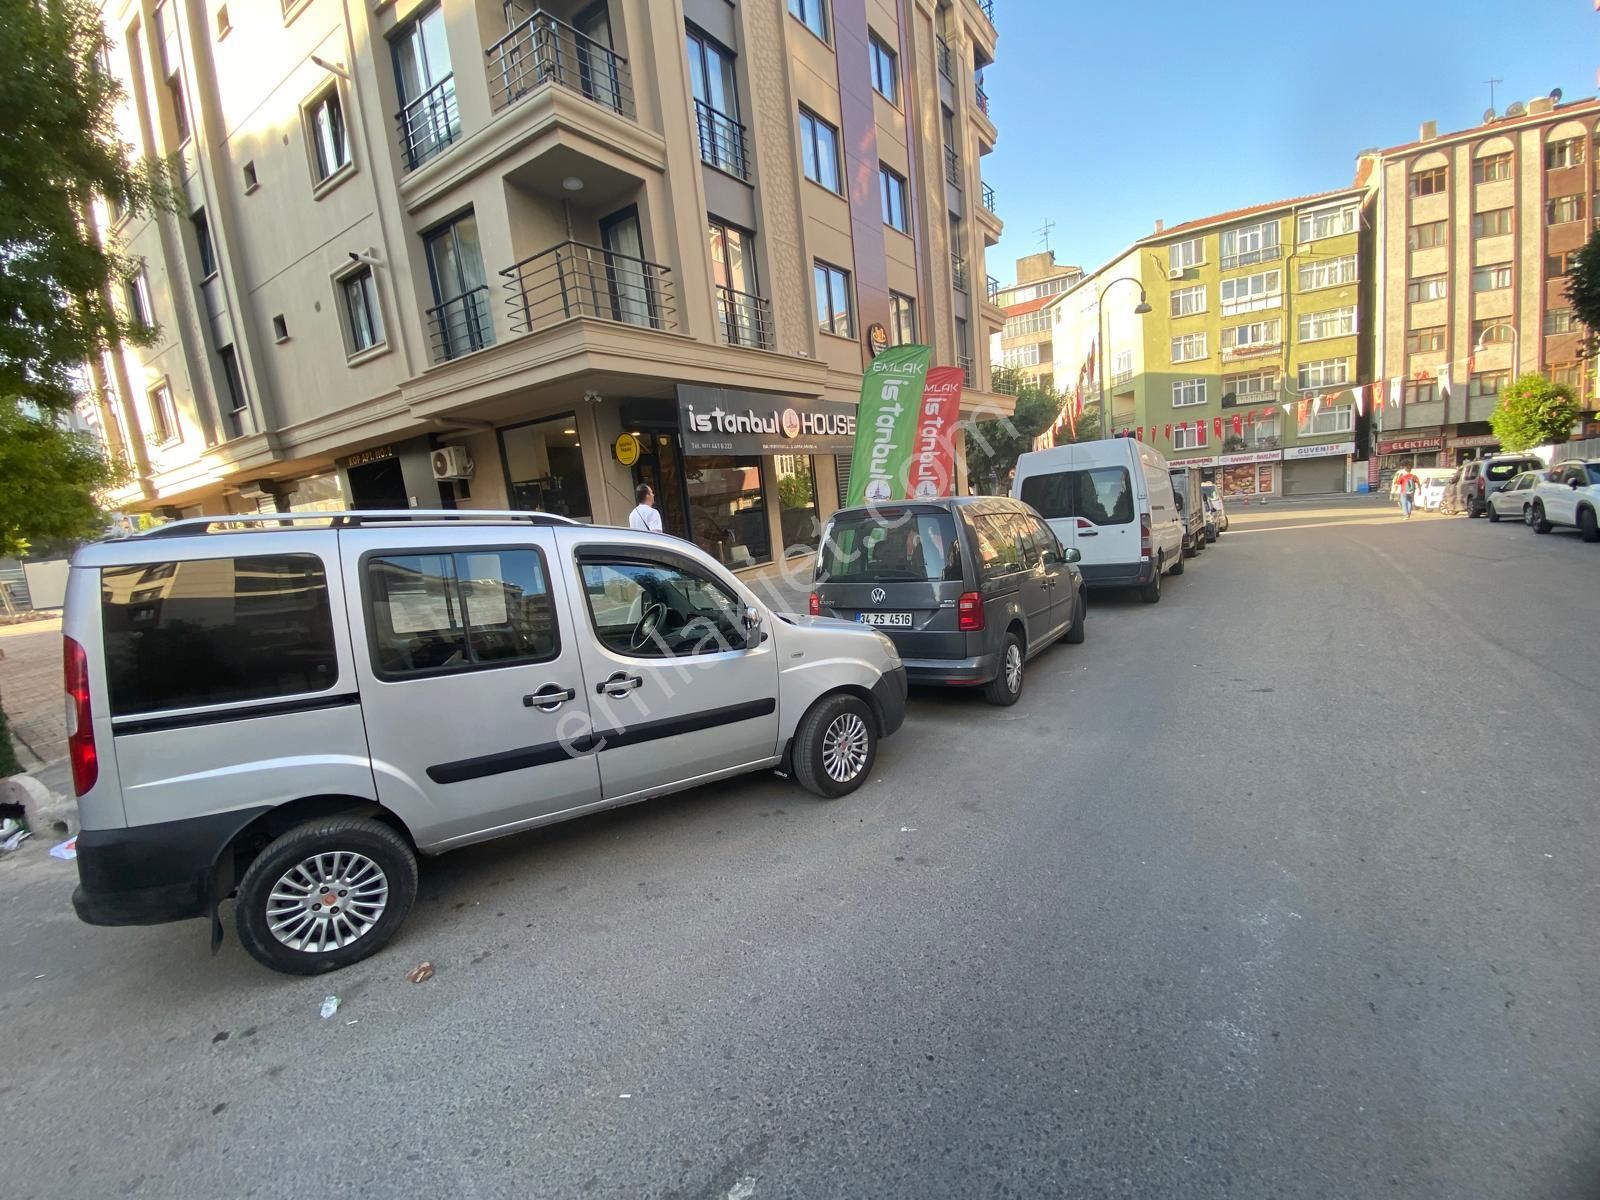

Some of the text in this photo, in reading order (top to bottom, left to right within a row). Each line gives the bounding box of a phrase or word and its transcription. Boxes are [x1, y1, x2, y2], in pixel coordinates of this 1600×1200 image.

[872, 361, 924, 374] EMLAK
[924, 383, 959, 393] MLAK
[688, 404, 857, 436] istanbul HOUSE
[869, 379, 909, 480] istanbul
[918, 397, 948, 481] istanbul
[860, 614, 911, 625] 34 ZS 4516
